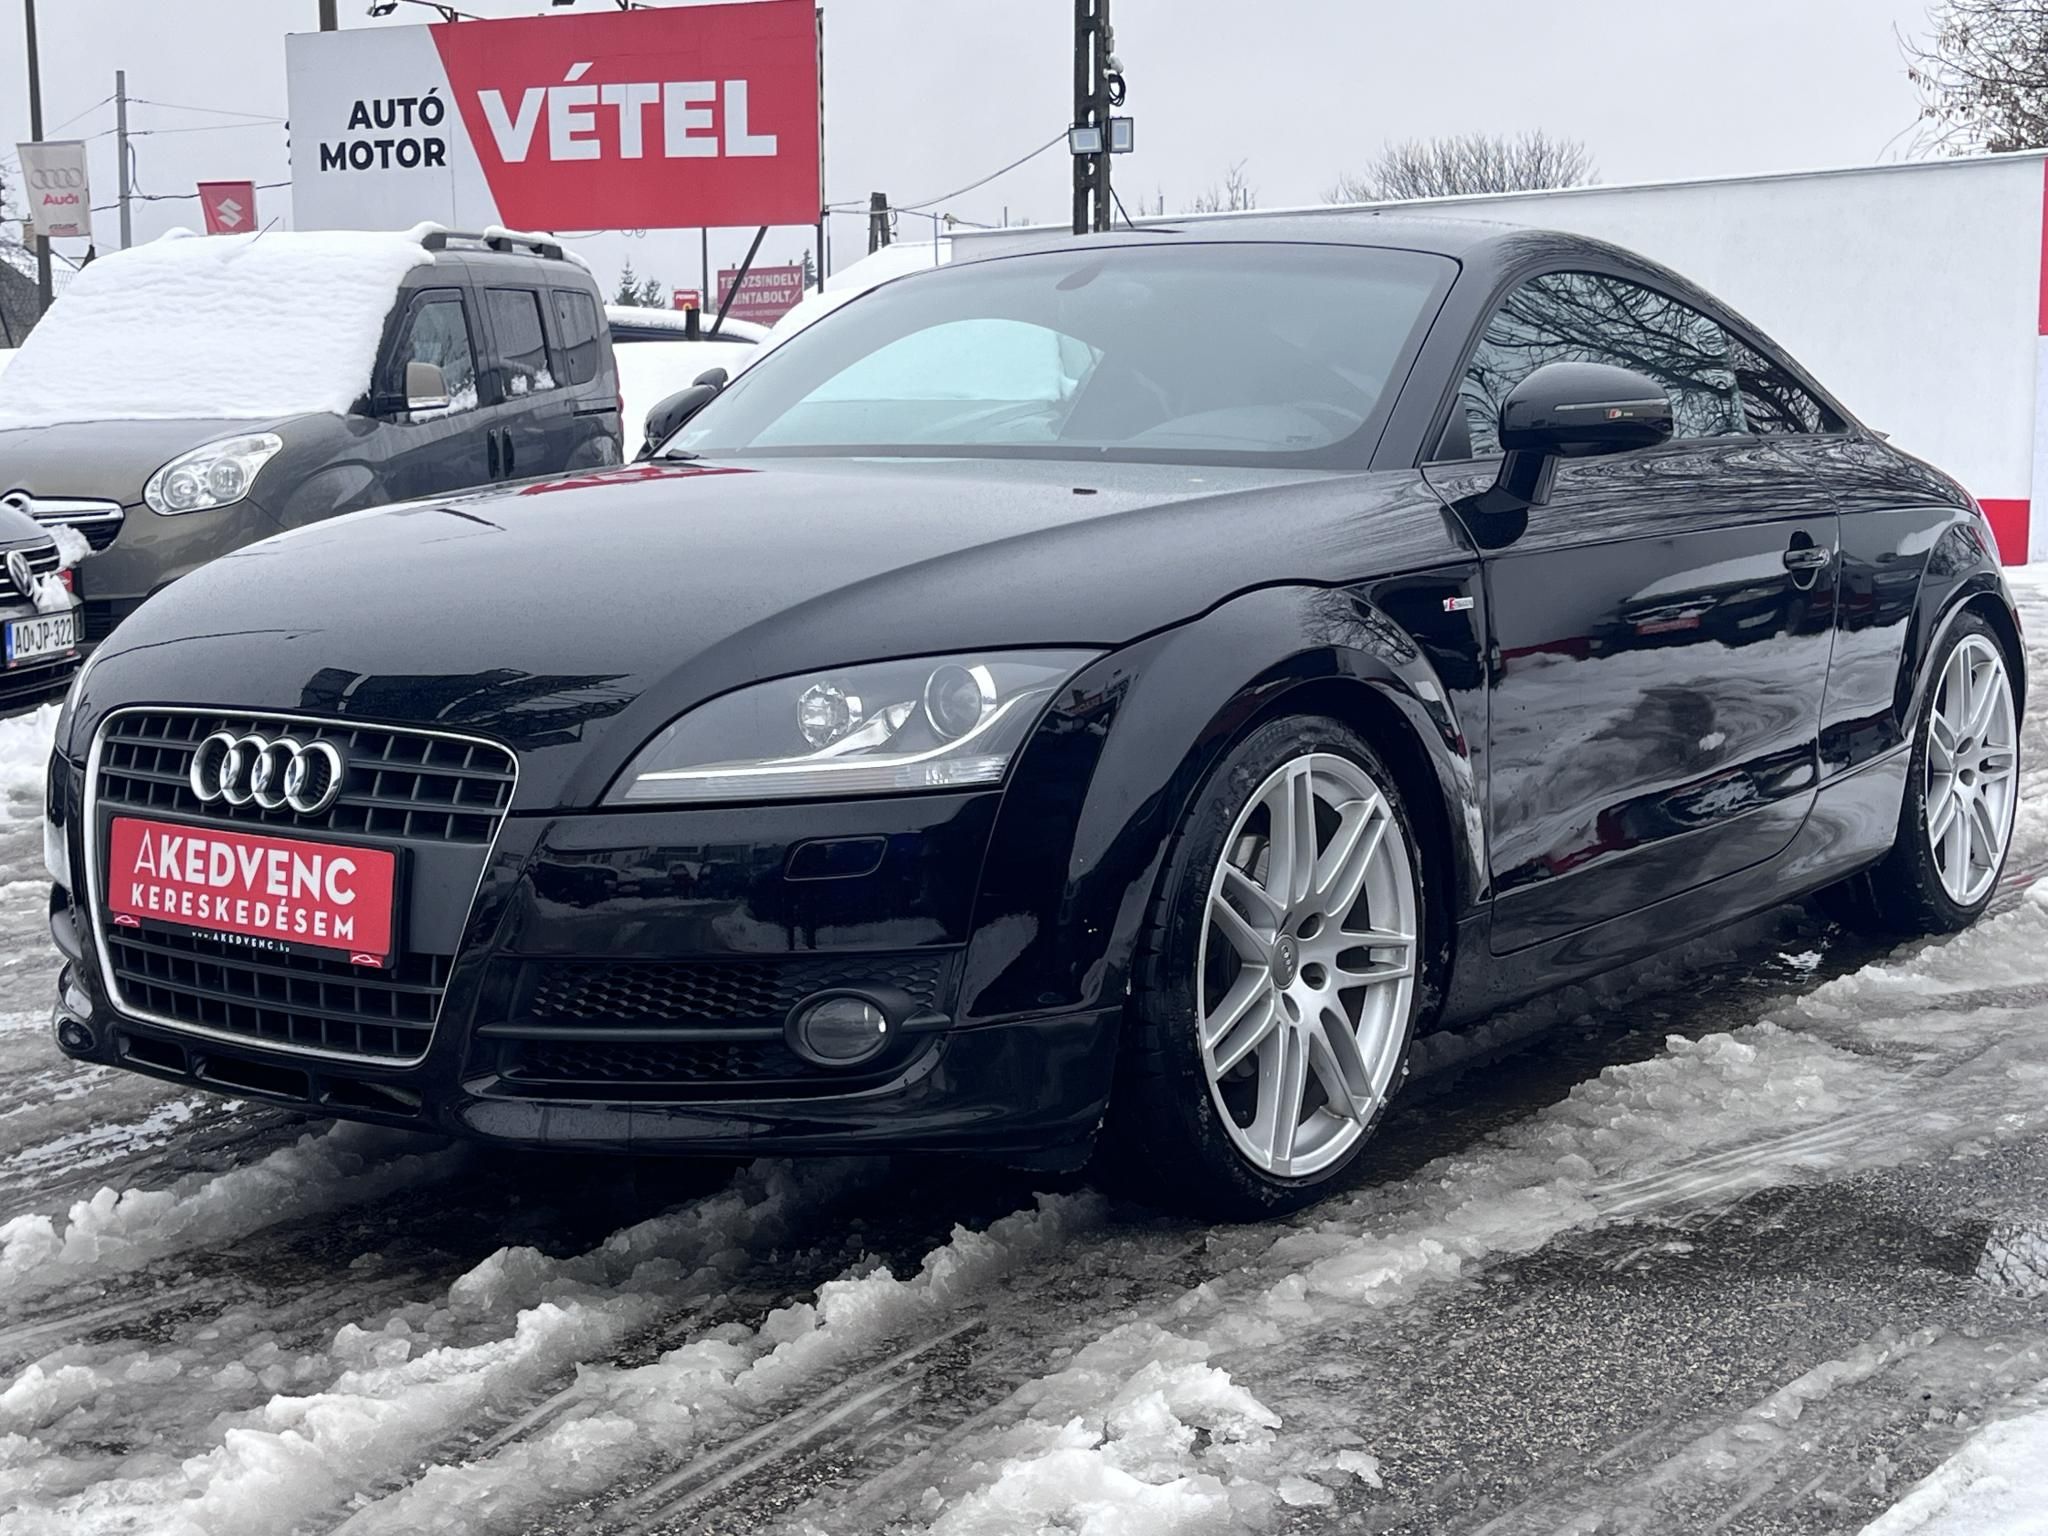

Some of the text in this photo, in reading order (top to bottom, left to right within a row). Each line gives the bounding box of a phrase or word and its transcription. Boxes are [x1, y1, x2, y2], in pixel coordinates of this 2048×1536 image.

[347, 87, 445, 130] AUTÓ
[477, 62, 778, 163] VÉTEL
[320, 138, 446, 171] MOTOR
[43, 193, 79, 205] Audi
[133, 828, 357, 905] AKEDVENC
[131, 883, 355, 941] KERESKEDÉSEM
